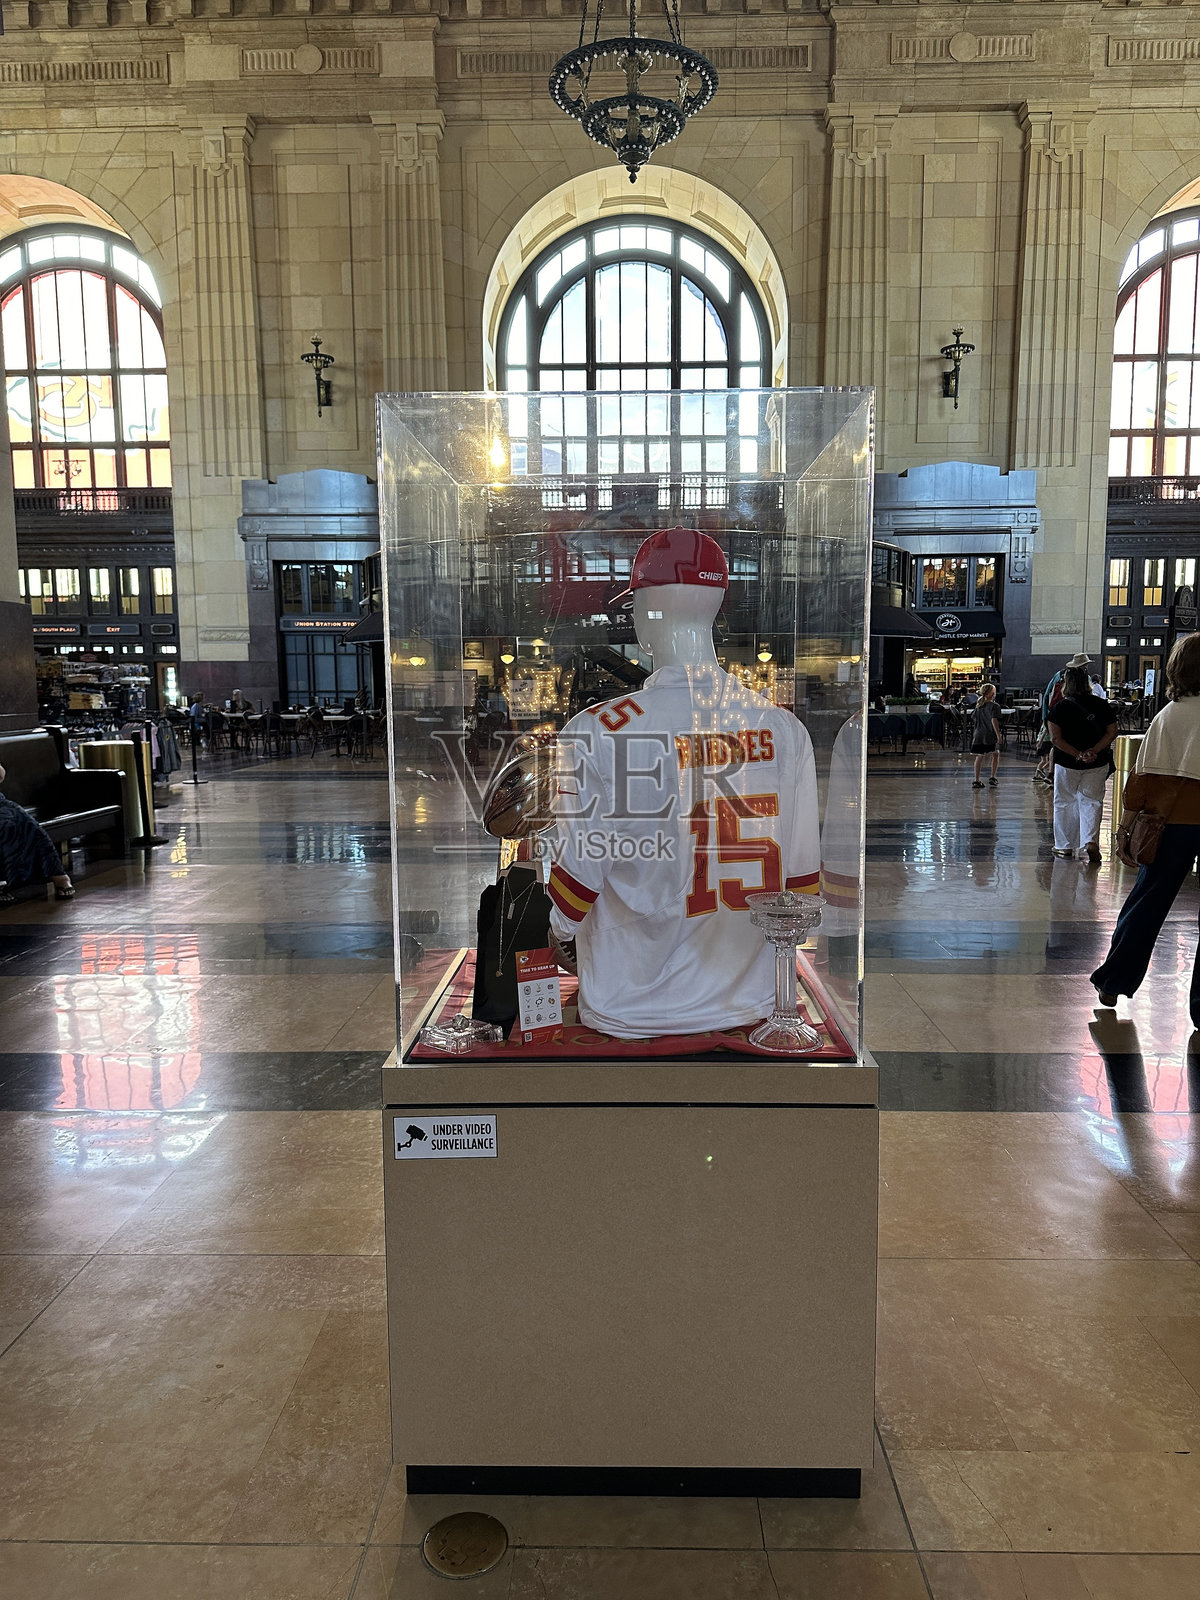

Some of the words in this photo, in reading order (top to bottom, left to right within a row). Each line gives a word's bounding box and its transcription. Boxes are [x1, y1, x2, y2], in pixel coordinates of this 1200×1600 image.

[686, 793, 782, 918] 15
[433, 1124, 462, 1135] UNDER
[465, 1123, 491, 1135] VIDEO
[431, 1138, 494, 1150] SURVEILLANCE
